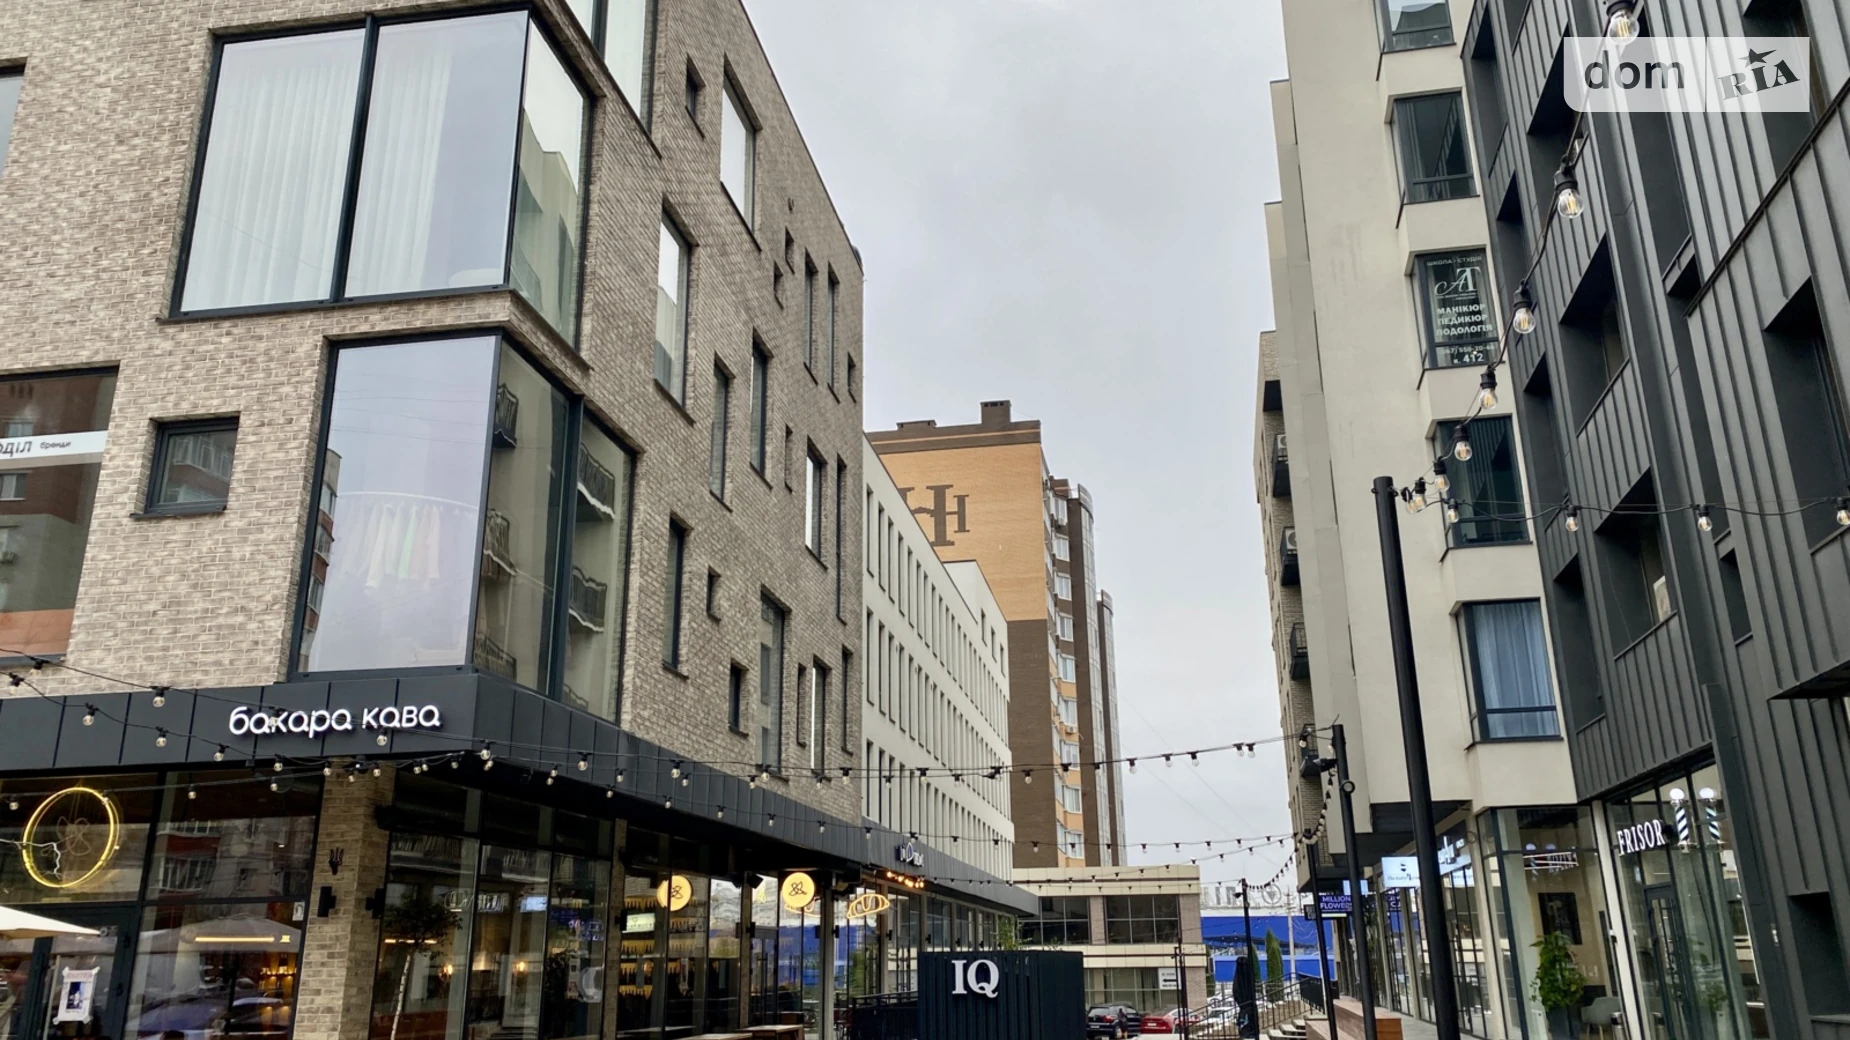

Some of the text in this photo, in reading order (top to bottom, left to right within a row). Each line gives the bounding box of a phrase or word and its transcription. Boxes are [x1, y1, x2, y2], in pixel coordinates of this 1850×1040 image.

[1437, 304, 1486, 314] МАНІКЮР
[1438, 314, 1488, 325] ПЕДИКЮР
[1436, 324, 1493, 336] ПОДОЛОГІЯ
[1463, 353, 1484, 363] 412
[229, 705, 442, 739] бакара кава
[1617, 819, 1666, 856] FRISOR
[951, 959, 1000, 998] IQ
